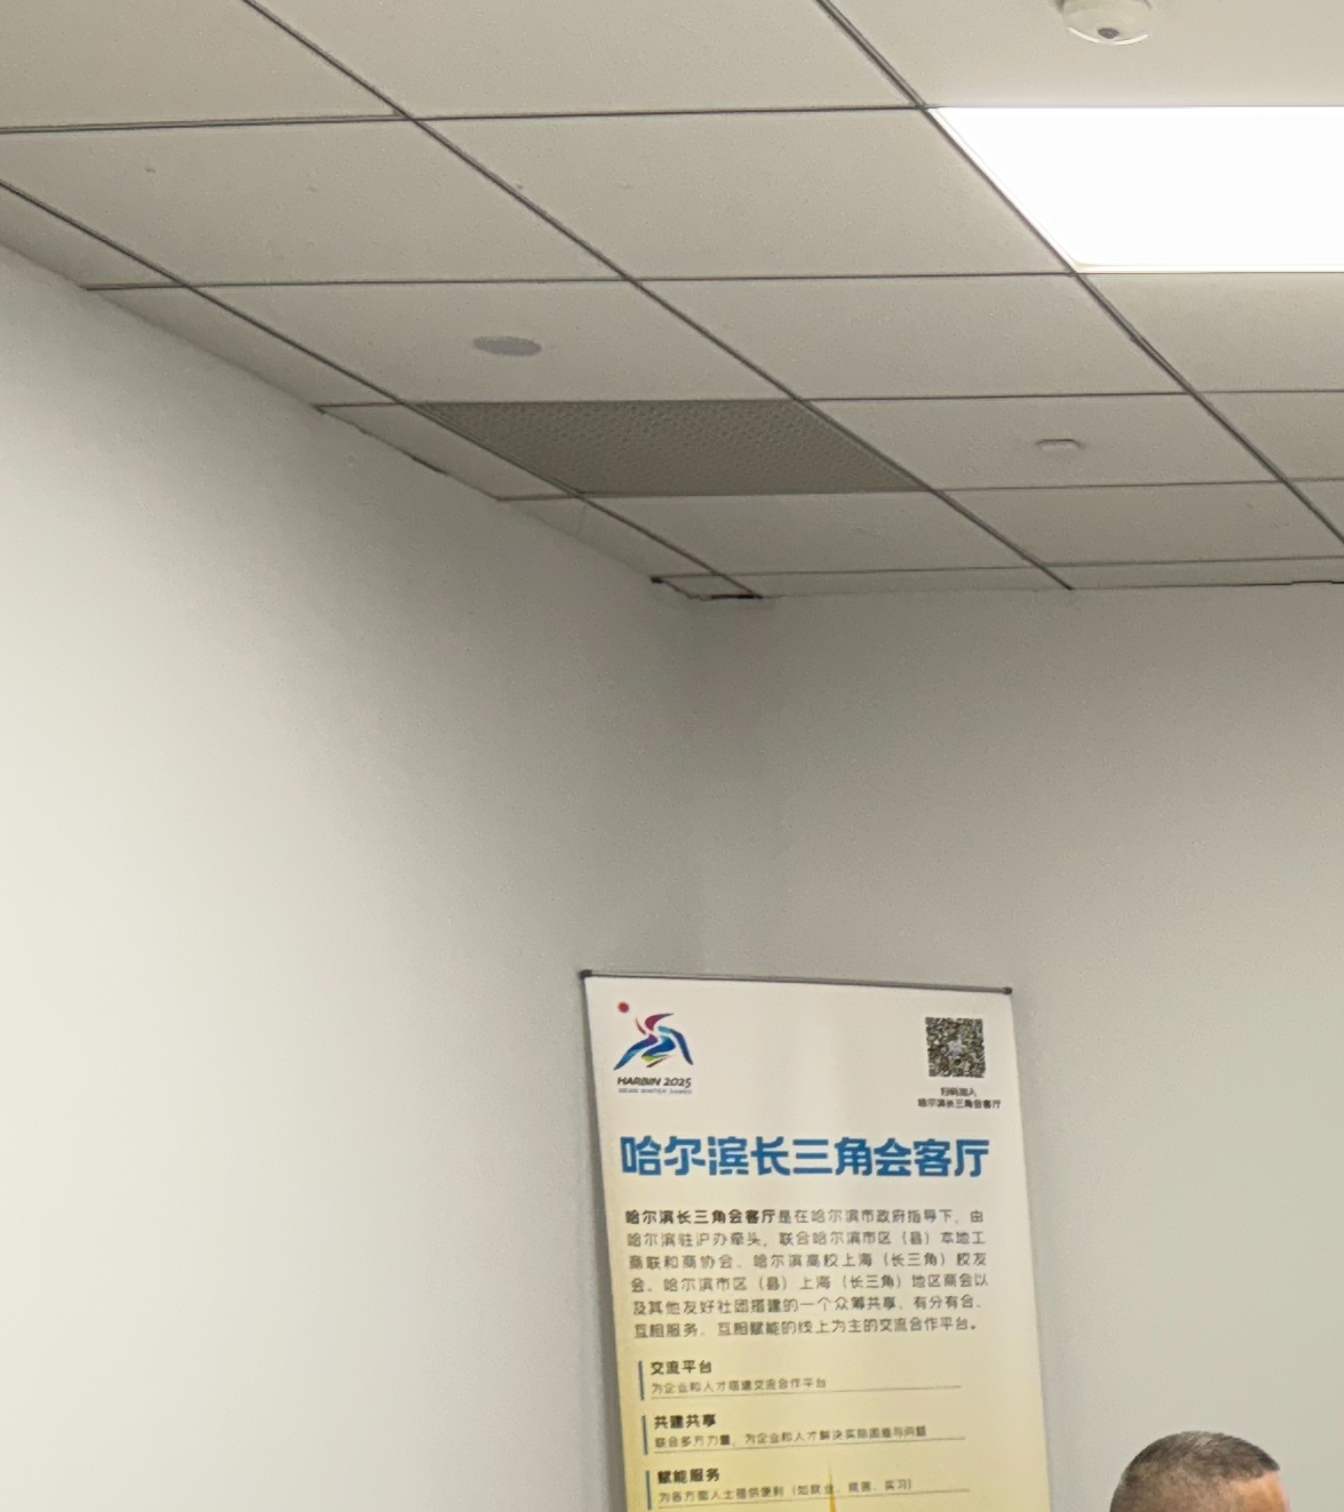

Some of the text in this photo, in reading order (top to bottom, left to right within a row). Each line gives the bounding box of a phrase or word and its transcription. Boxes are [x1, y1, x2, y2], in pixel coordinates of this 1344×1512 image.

[617, 1076, 692, 1089] HARBIN 2025
[619, 1135, 990, 1178] 哈尔滨长三角会客厅
[650, 1359, 713, 1376] 交流平台
